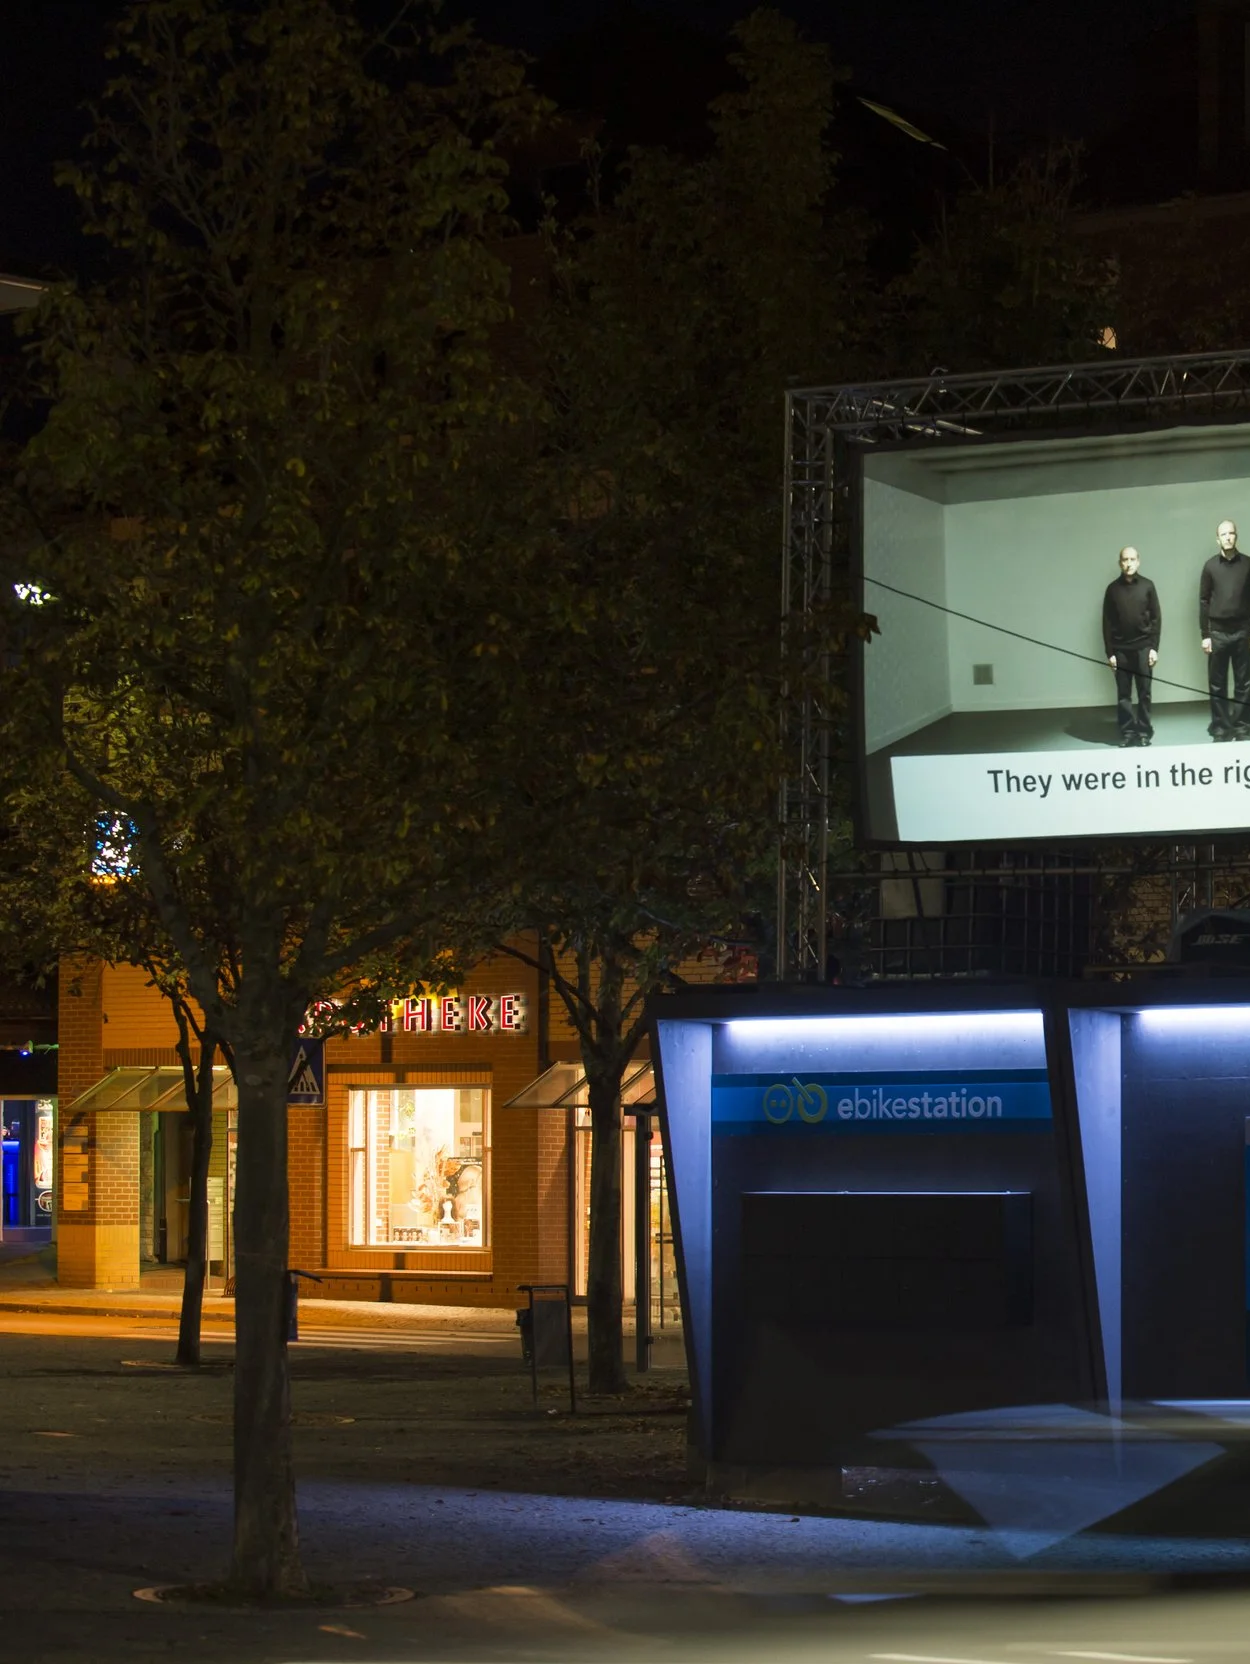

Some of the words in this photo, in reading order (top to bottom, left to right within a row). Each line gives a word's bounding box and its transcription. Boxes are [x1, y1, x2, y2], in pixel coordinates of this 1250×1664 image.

[986, 769, 1053, 798] They
[1061, 771, 1127, 791] were
[1136, 764, 1160, 788] in
[1169, 762, 1213, 786] the
[299, 995, 515, 1033] THEKE
[836, 1087, 1003, 1119] ebikestation
